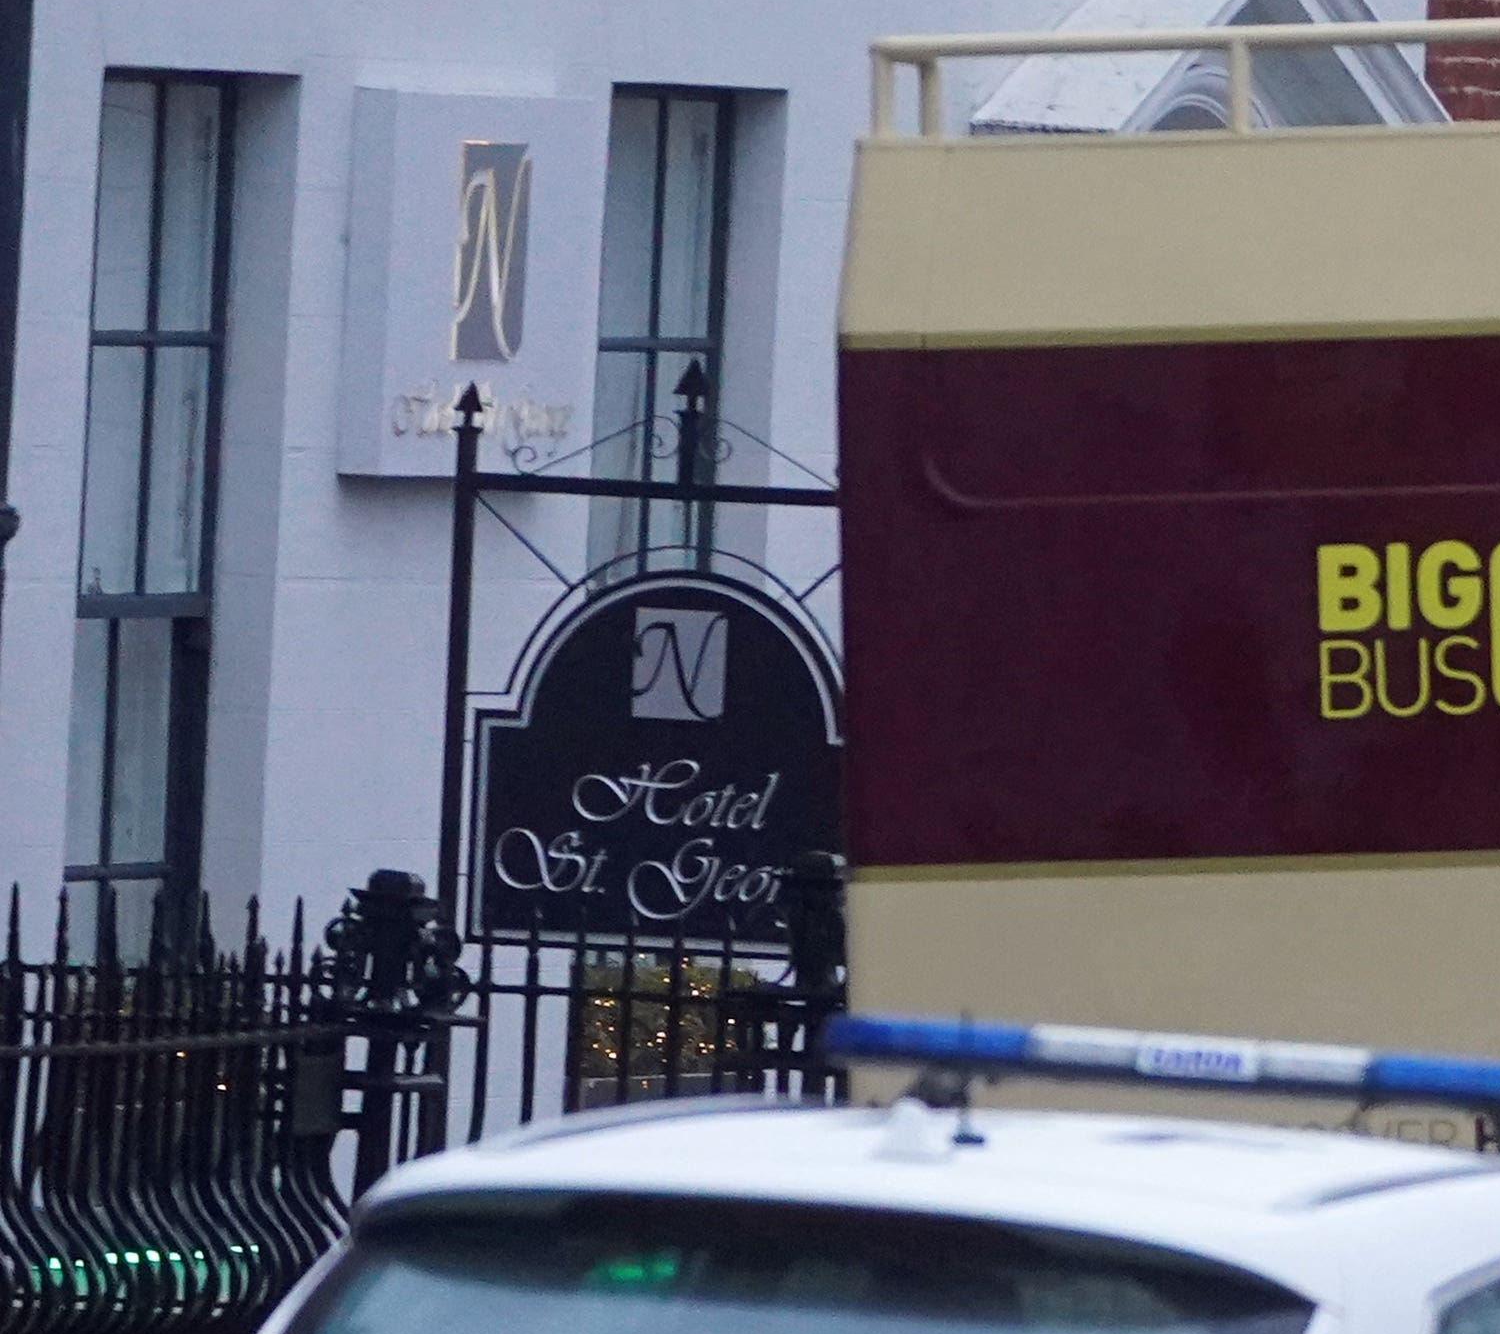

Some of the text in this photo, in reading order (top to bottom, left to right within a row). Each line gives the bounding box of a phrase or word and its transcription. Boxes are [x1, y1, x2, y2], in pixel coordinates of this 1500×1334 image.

[1316, 539, 1484, 632] BIG
[1318, 634, 1487, 720] BUS
[571, 758, 780, 831] Hotel
[626, 837, 796, 922] Geor
